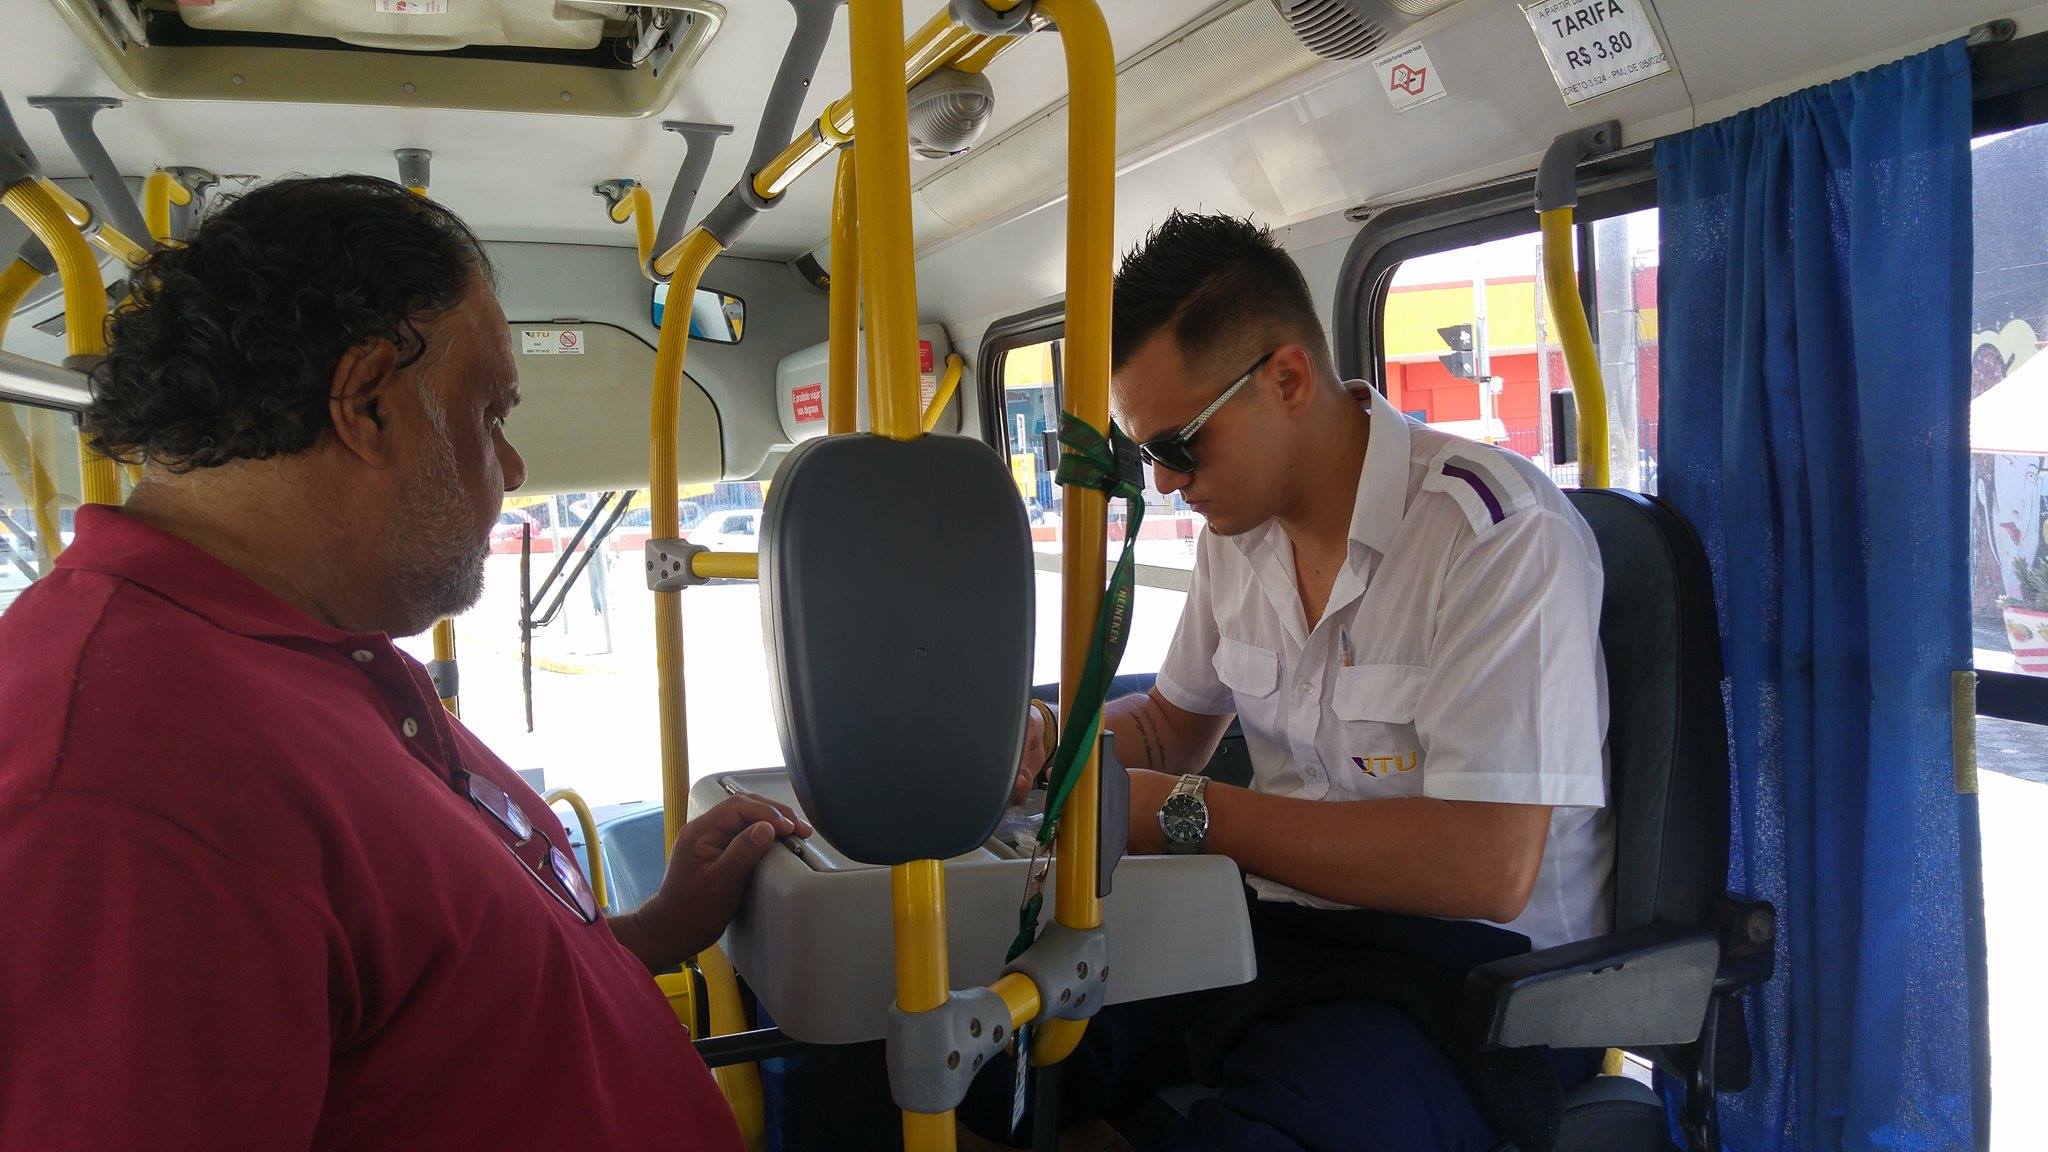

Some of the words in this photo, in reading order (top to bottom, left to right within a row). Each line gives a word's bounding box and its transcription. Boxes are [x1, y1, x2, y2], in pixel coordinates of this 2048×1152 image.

[1539, 10, 1546, 18] A
[1545, 0, 1573, 16] PARTIR
[1552, 0, 1624, 38] TARIFA
[1566, 46, 1592, 69] R$
[1593, 30, 1633, 59] 3,80
[1627, 62, 1639, 74] DE
[1109, 590, 1128, 643] HEINEKEN
